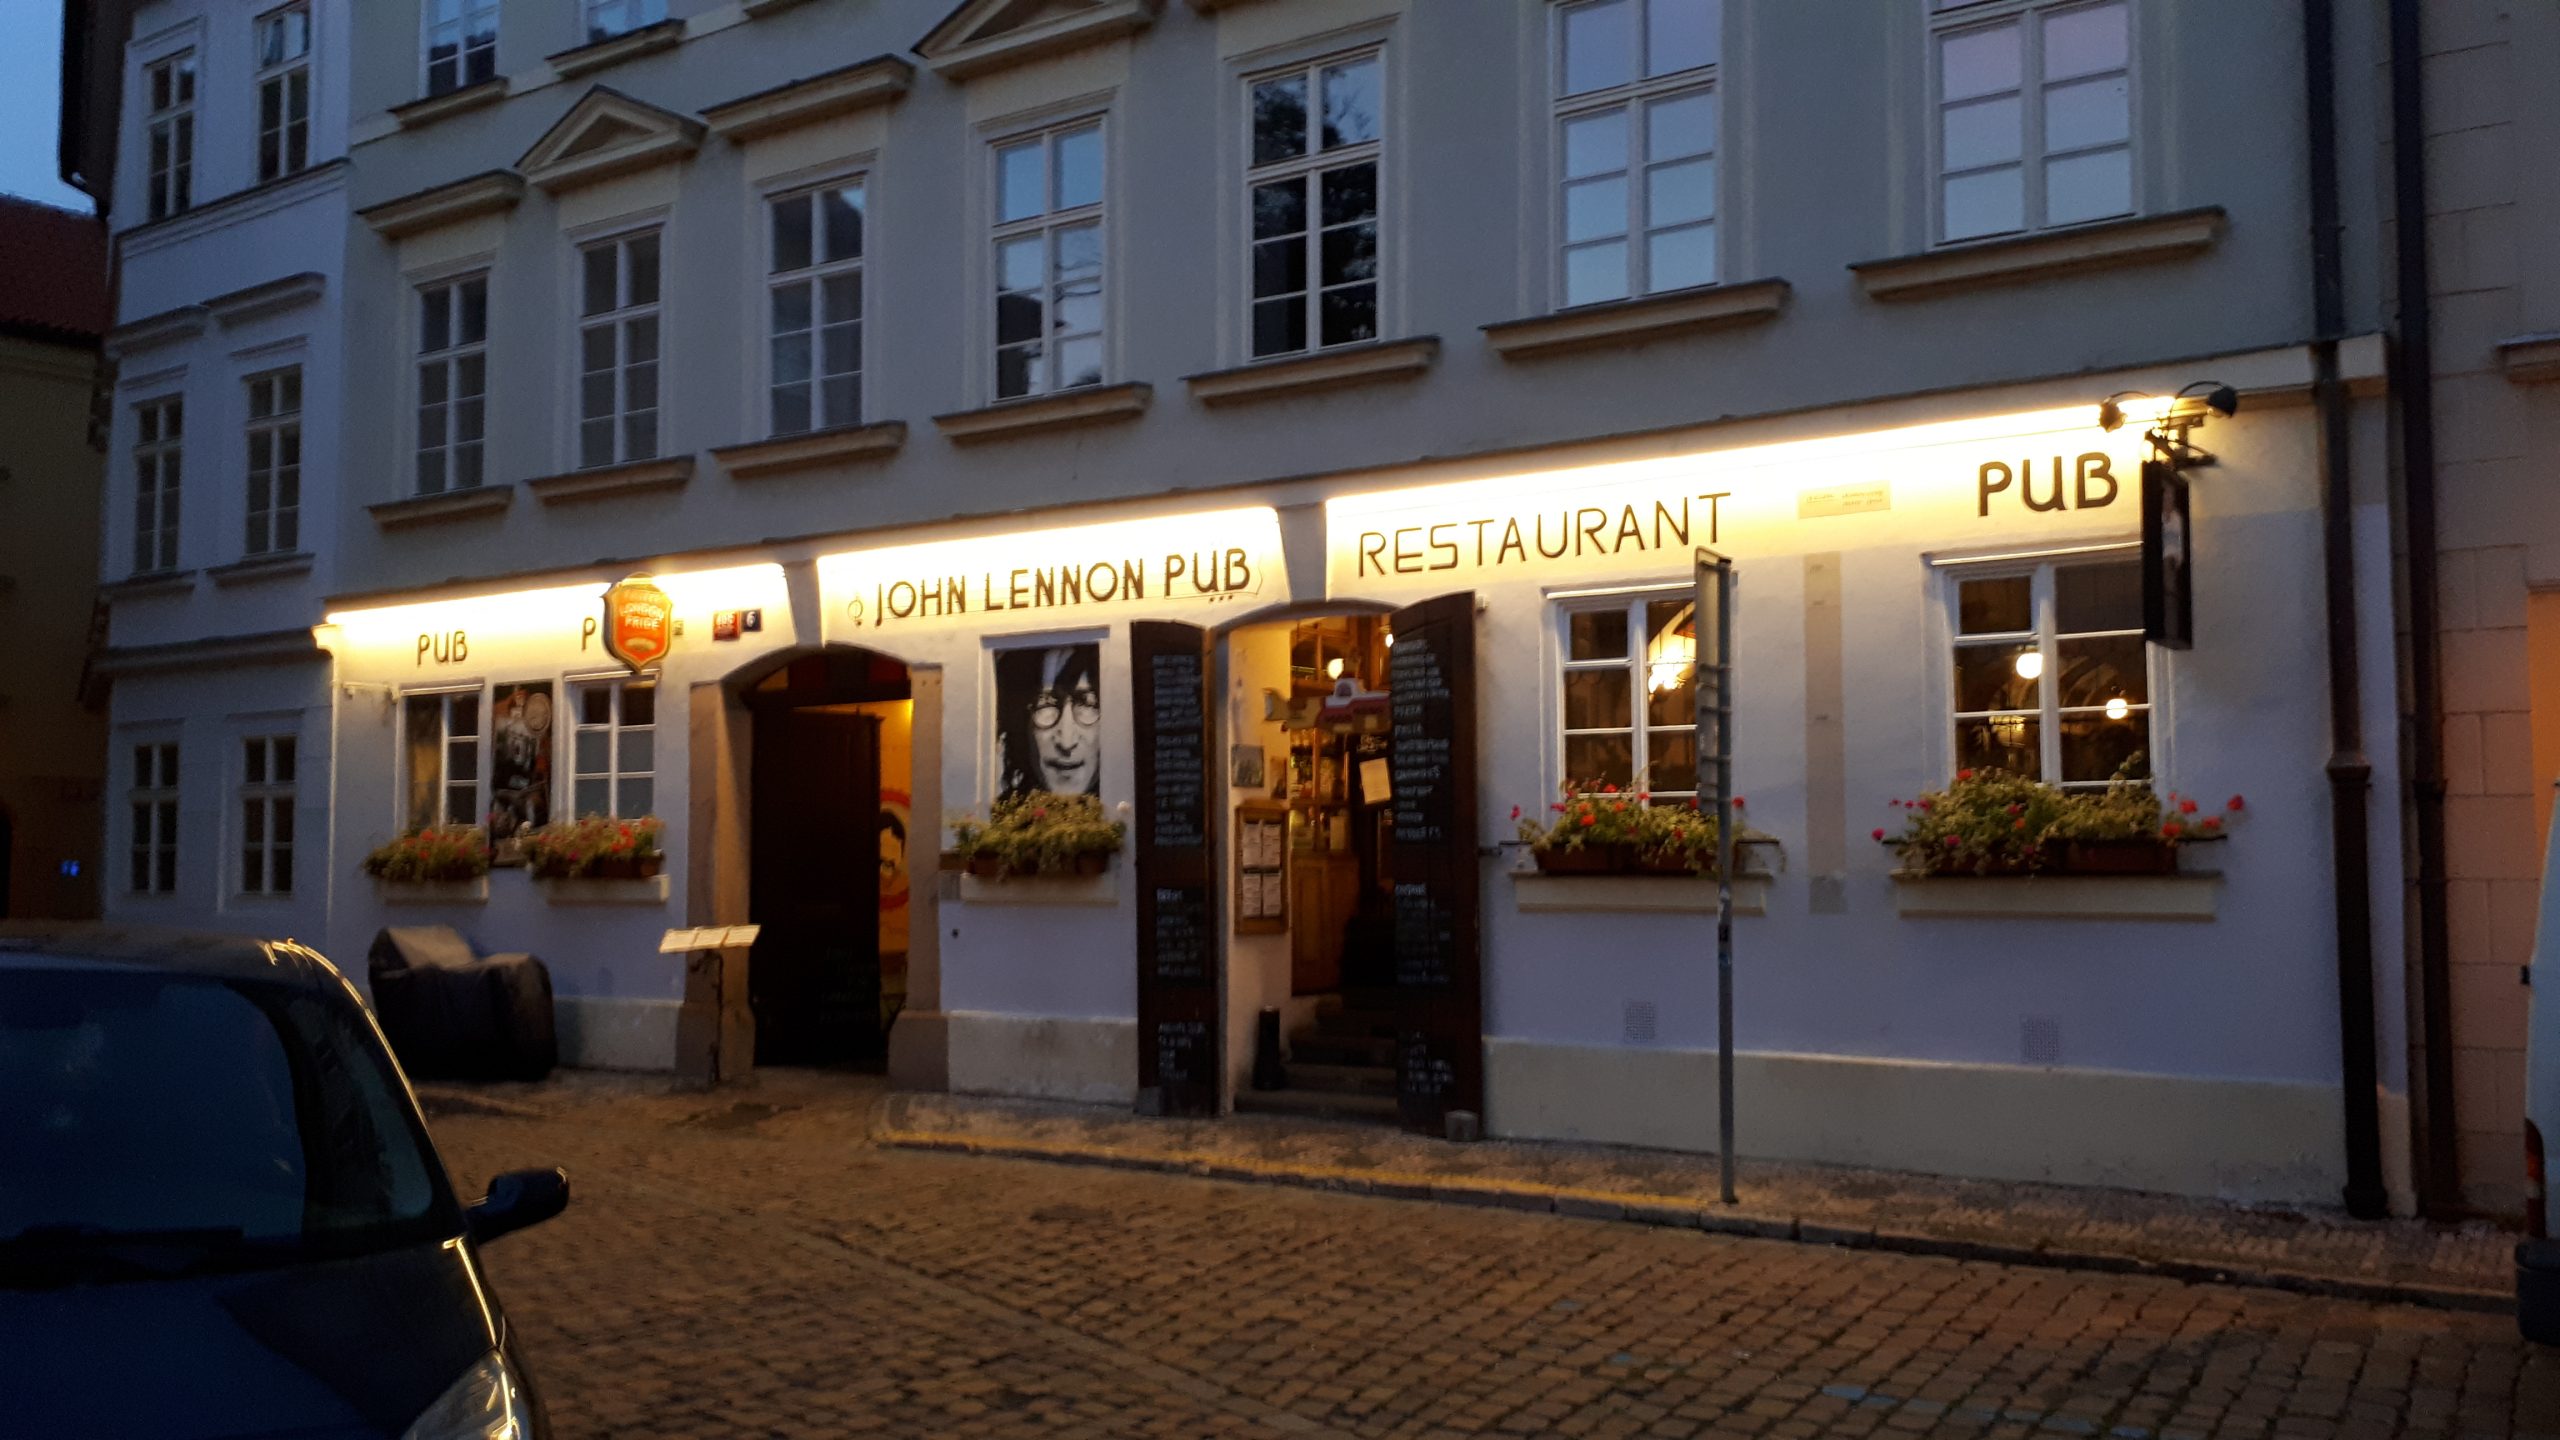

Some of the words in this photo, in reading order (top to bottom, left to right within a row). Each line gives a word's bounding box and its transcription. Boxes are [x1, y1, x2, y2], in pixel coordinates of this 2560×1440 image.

[1979, 452, 2119, 517] PUB
[1358, 492, 1732, 578] RESTAURANT
[874, 574, 966, 627] JOHN
[984, 557, 1145, 611] LENNON
[1164, 547, 1252, 597] PUB
[624, 615, 661, 631] PRIDE
[746, 611, 756, 627] 6
[417, 630, 468, 667] PUB
